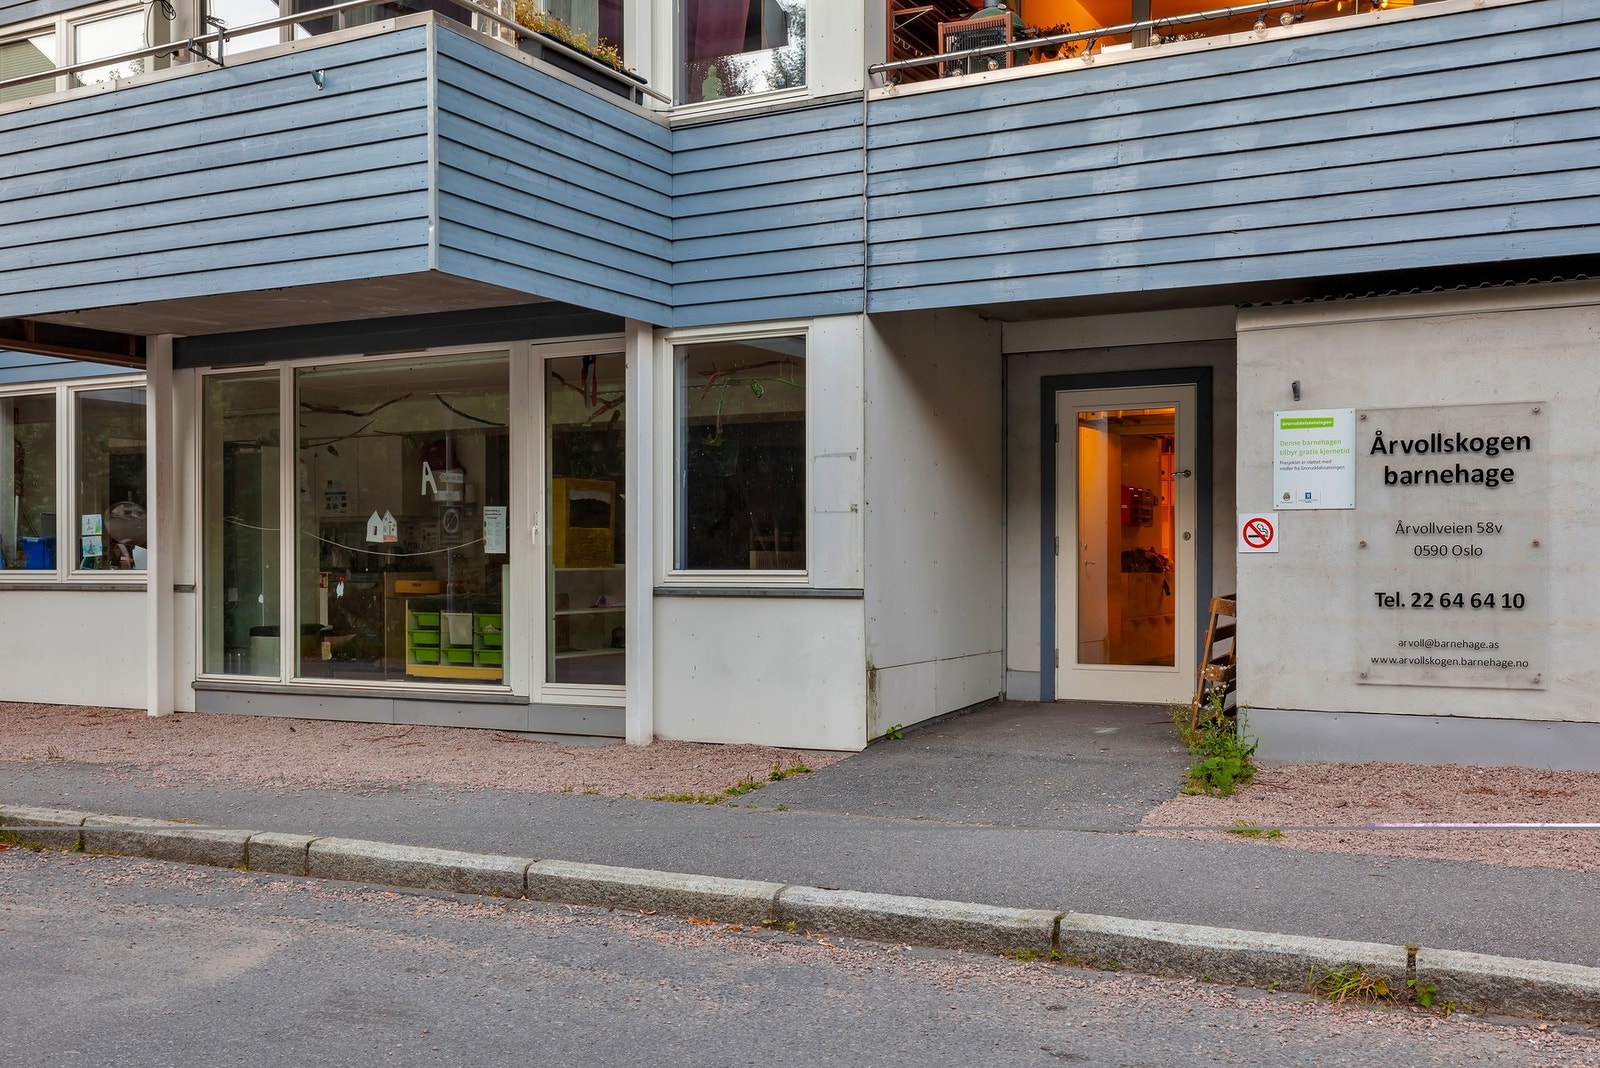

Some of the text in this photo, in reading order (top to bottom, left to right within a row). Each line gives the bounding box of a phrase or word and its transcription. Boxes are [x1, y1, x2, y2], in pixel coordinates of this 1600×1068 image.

[1370, 430, 1531, 457] Årvollskogen
[1320, 447, 1350, 456] kjernetid
[1384, 463, 1515, 488] barnehage
[1395, 519, 1503, 535] Årvollveien 58v
[1413, 544, 1483, 558] 0590 Oslo
[1374, 592, 1526, 610] Tel. 22 64 64 10
[1398, 638, 1500, 650] arvoll@barnehage.as
[1370, 655, 1529, 669] www.arvollskogen.barnehage.no
